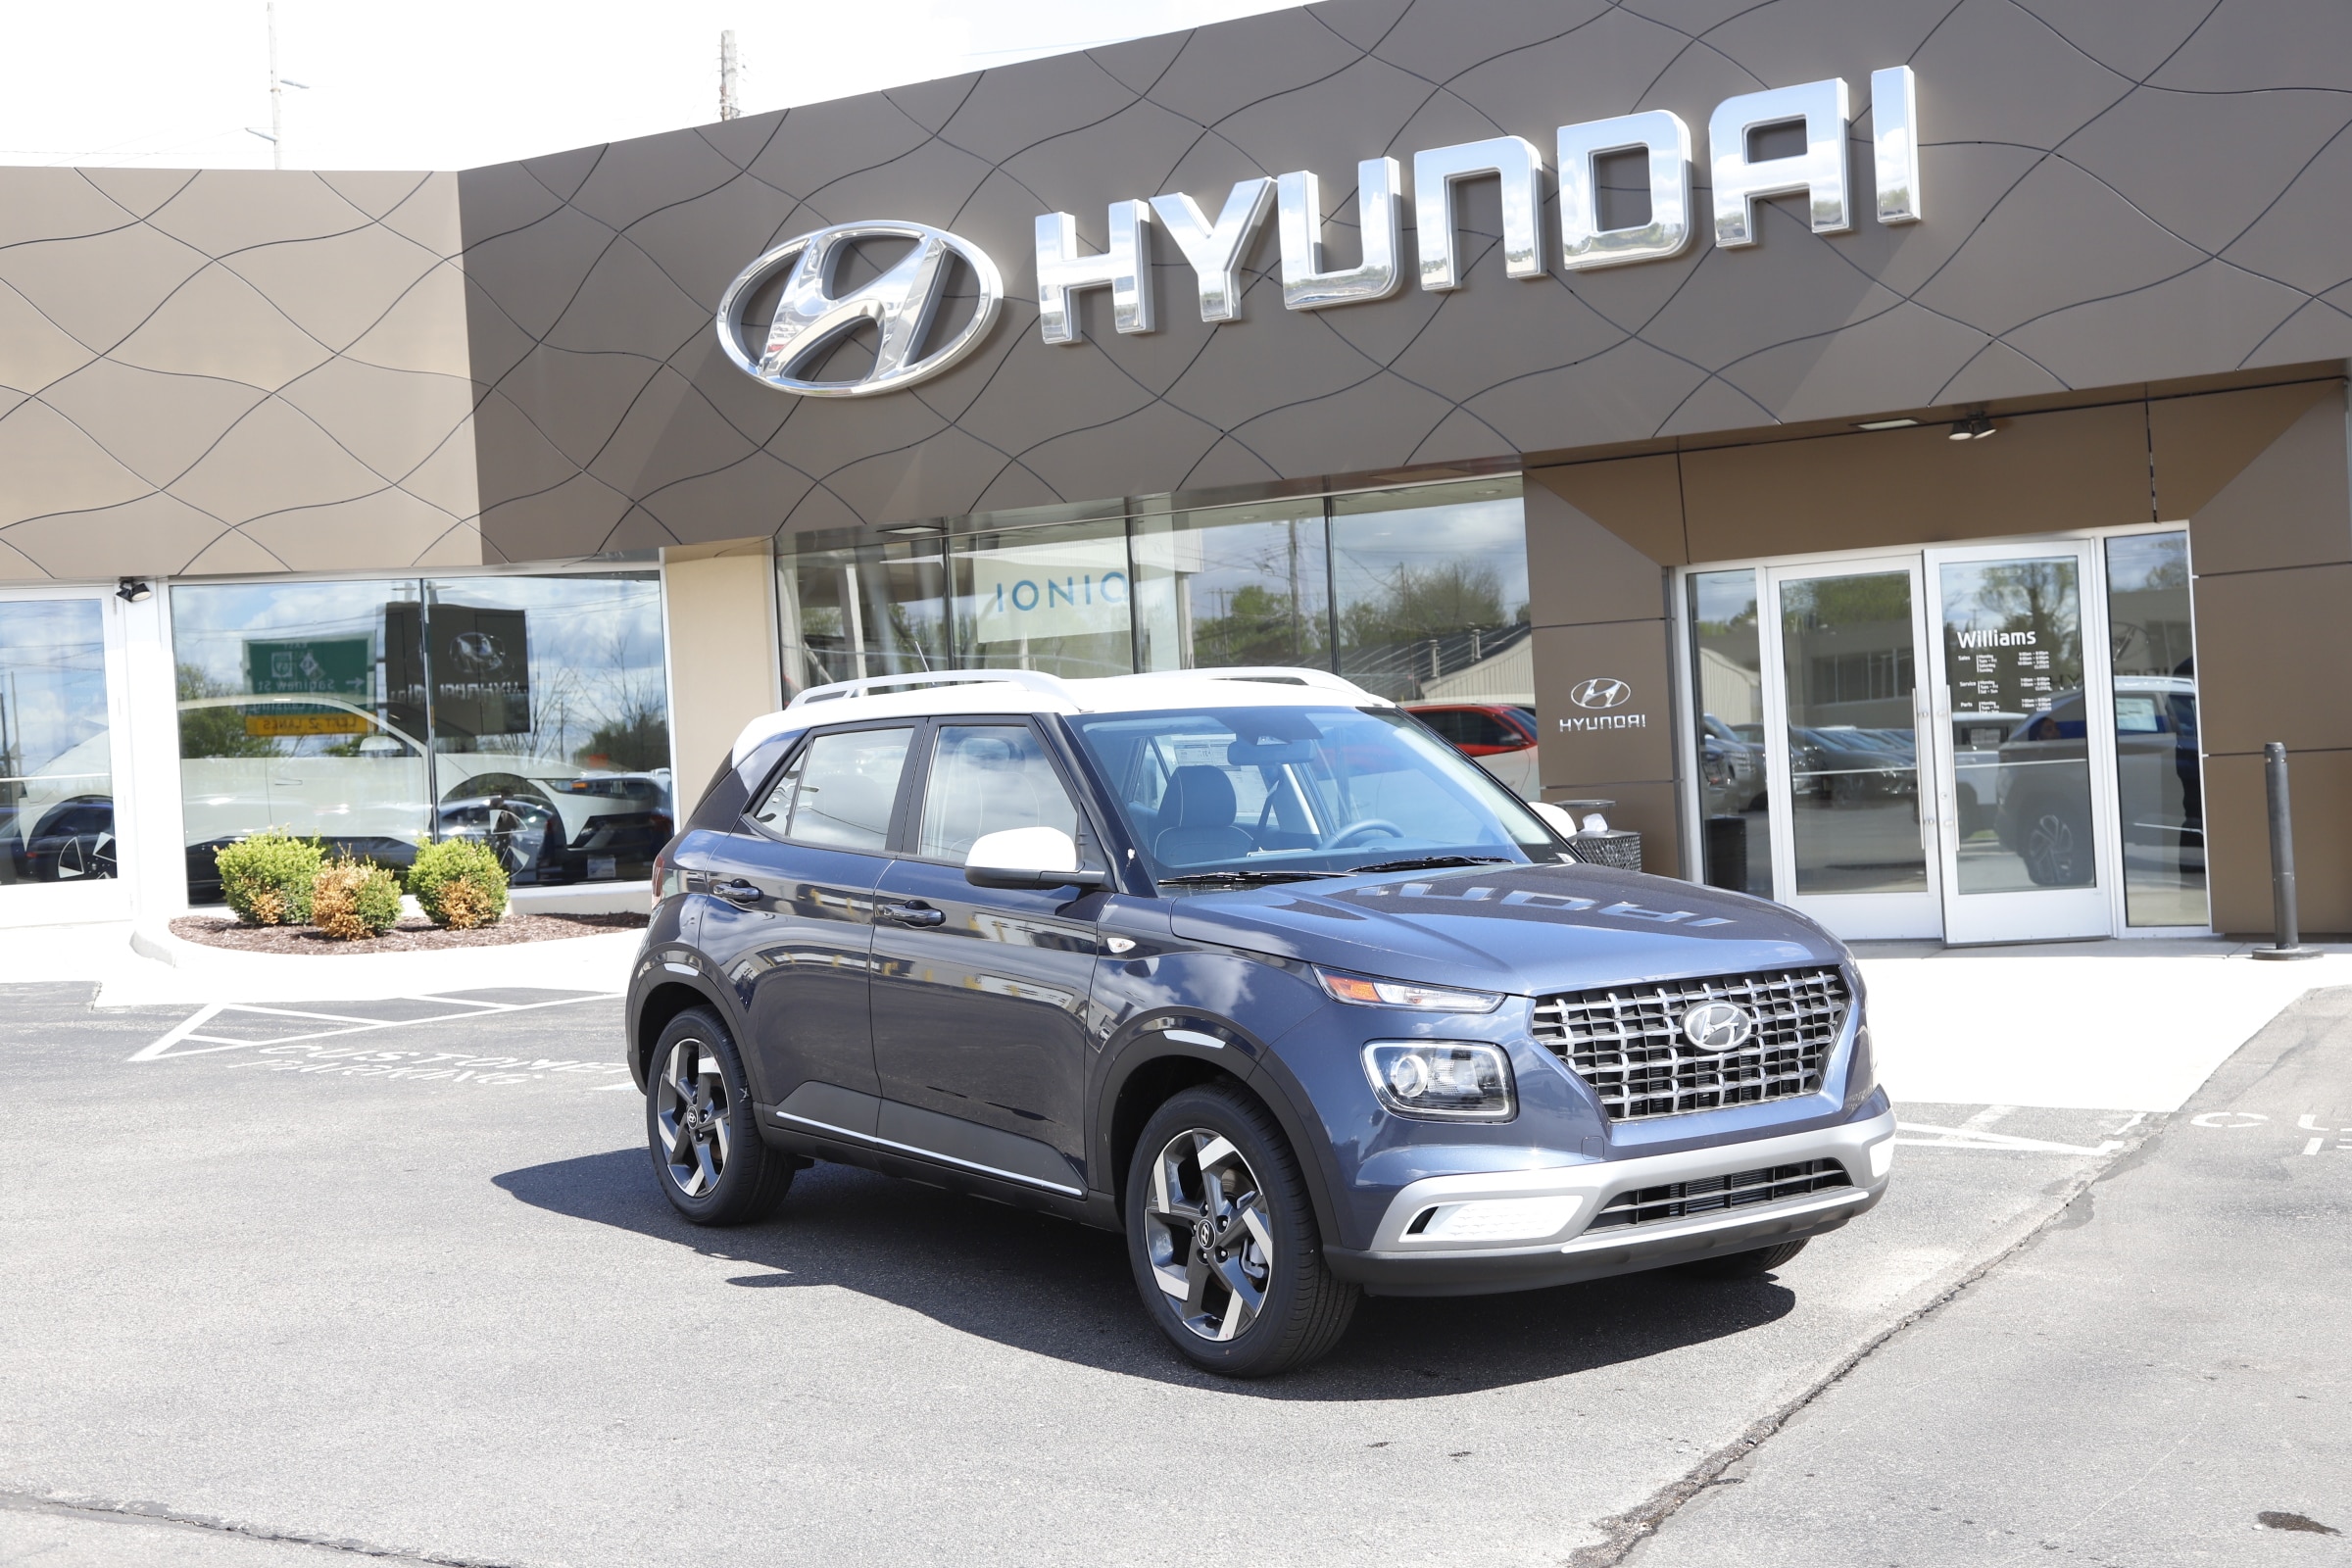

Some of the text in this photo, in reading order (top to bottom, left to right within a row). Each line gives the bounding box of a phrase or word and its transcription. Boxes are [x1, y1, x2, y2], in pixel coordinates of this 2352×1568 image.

[1035, 65, 1921, 345] HYUNDAI
[1956, 629, 2036, 649] Williams
[1559, 714, 1646, 732] HYUNDAI
